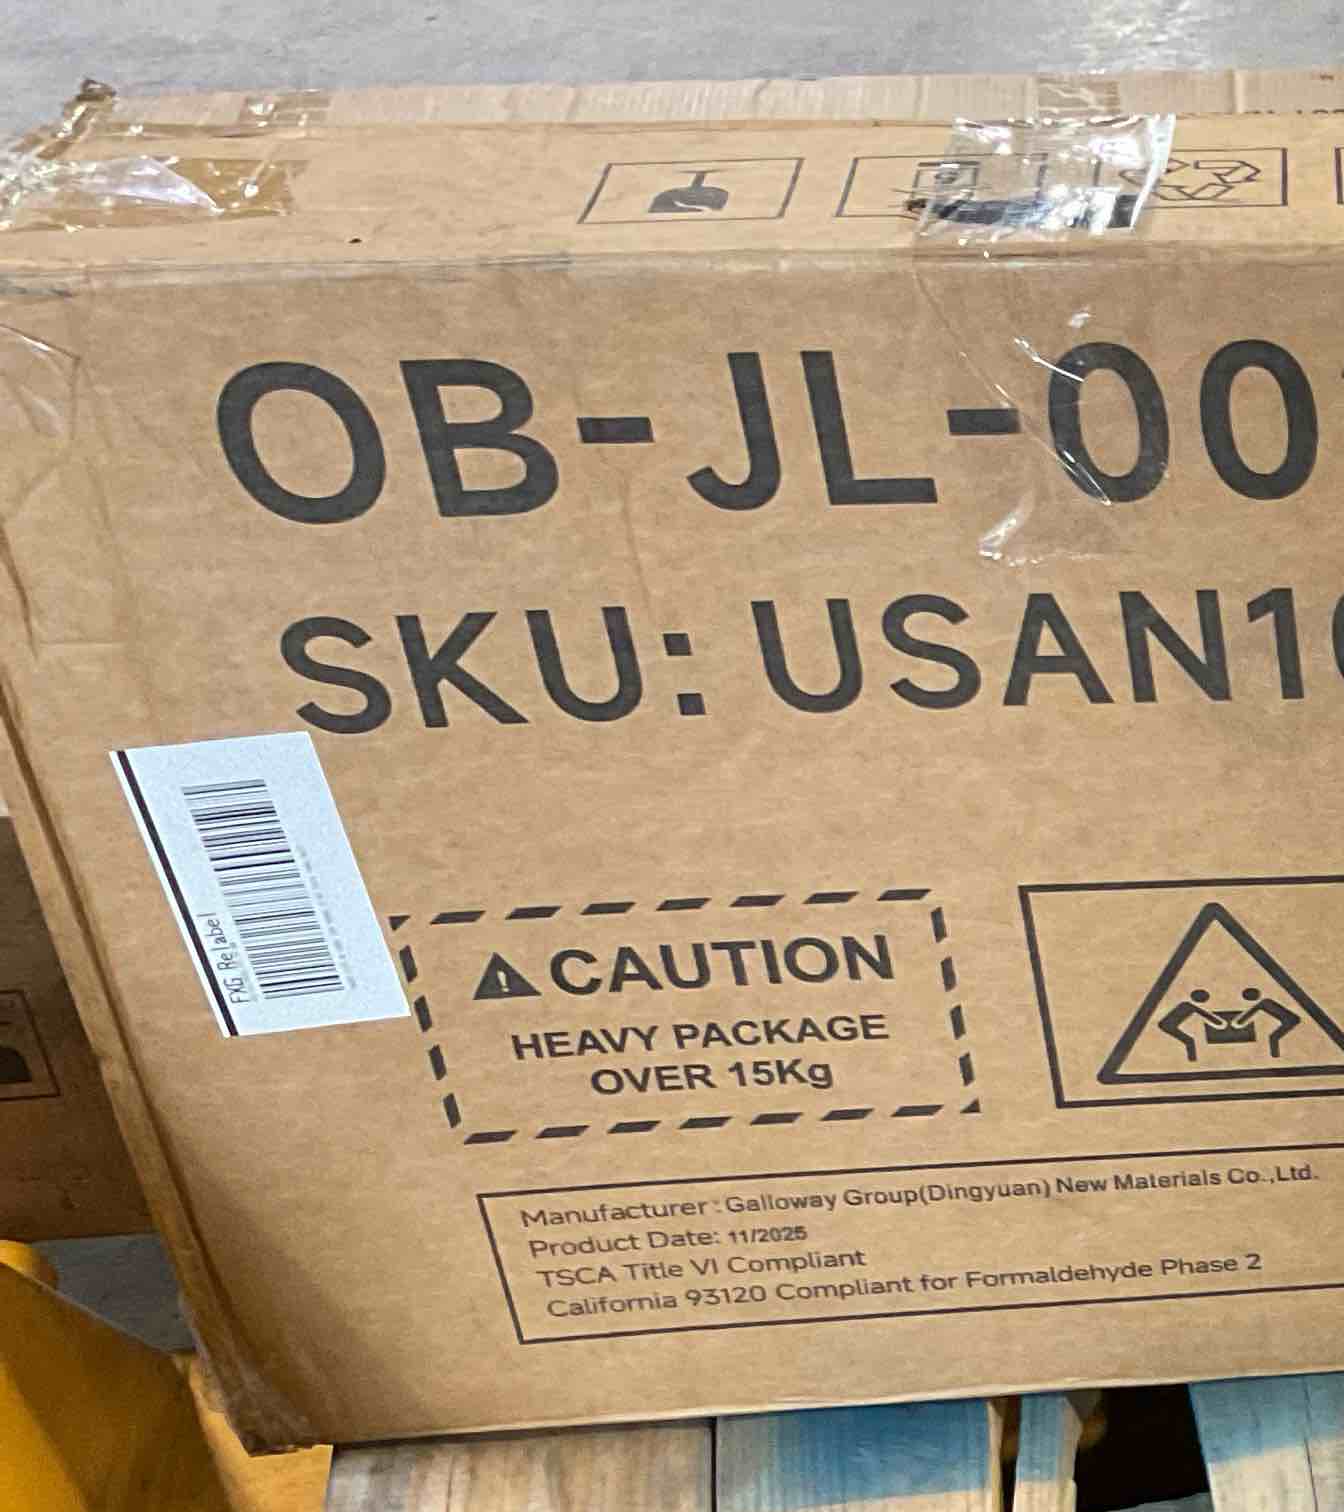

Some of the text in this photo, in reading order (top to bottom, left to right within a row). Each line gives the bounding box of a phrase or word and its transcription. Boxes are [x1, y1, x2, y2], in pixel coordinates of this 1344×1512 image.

[281, 606, 706, 736] SKU:
[549, 933, 894, 996] CAUTION
[511, 1013, 889, 1061] HEAVY PACKAGE
[590, 1058, 835, 1096] OVER 15Kg
[725, 1194, 837, 1213] Galloway
[843, 1180, 1052, 1207] Group(Dingyuan)
[1056, 1176, 1108, 1195] New
[1114, 1169, 1222, 1192] Materials
[528, 1225, 809, 1259] Product Date: 11/2025
[536, 1249, 867, 1289] TSCA Title VI Compliant
[546, 1252, 1264, 1319] California 93120 Compliant for Formaldehyde Phase 2
